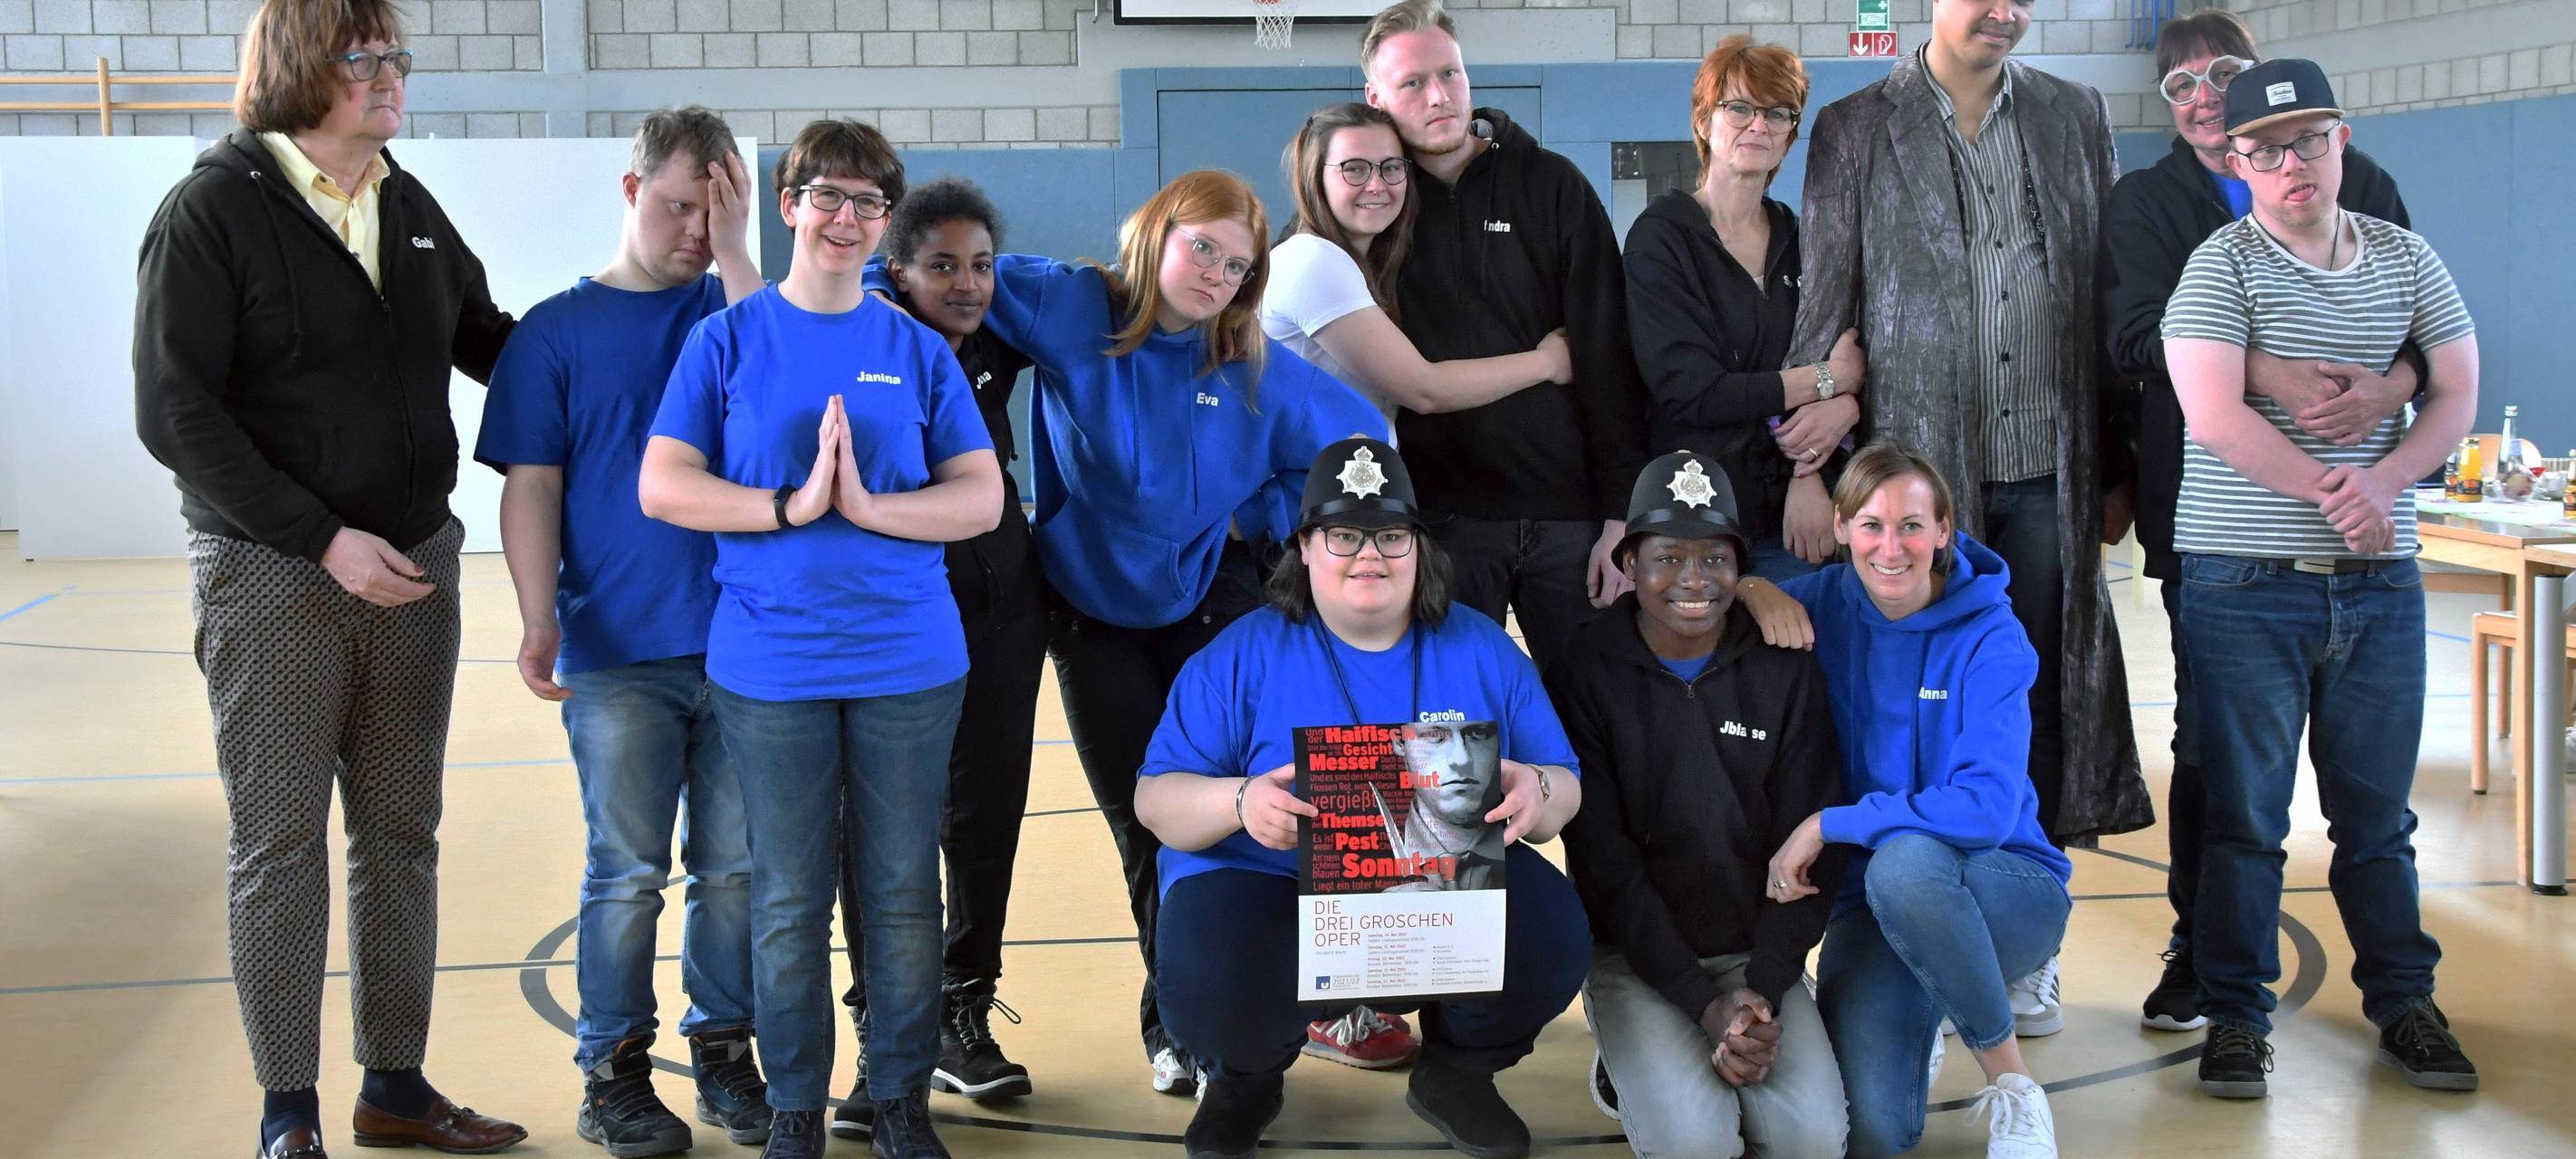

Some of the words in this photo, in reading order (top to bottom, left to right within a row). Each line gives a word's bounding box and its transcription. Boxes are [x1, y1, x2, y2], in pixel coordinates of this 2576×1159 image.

[412, 236, 435, 249] Gabi
[857, 371, 901, 385] Janina
[1197, 392, 1219, 407] Eva
[1918, 686, 1948, 700] Anna
[1419, 708, 1466, 723] Carolin
[1325, 725, 1417, 742] Haifisch
[1343, 742, 1393, 757] Gesicht
[1309, 753, 1379, 771] Messer
[1399, 771, 1439, 789] Blut
[1311, 790, 1378, 813] vergießt
[1320, 813, 1384, 829] Themse
[1335, 831, 1379, 850] Pest
[1342, 851, 1456, 880] Sonntag
[1337, 881, 1350, 890] ein
[1315, 900, 1341, 915] DIE
[1315, 916, 1353, 931] DREI
[1360, 913, 1453, 930] GROSCHEN
[1315, 932, 1360, 947] OPER
